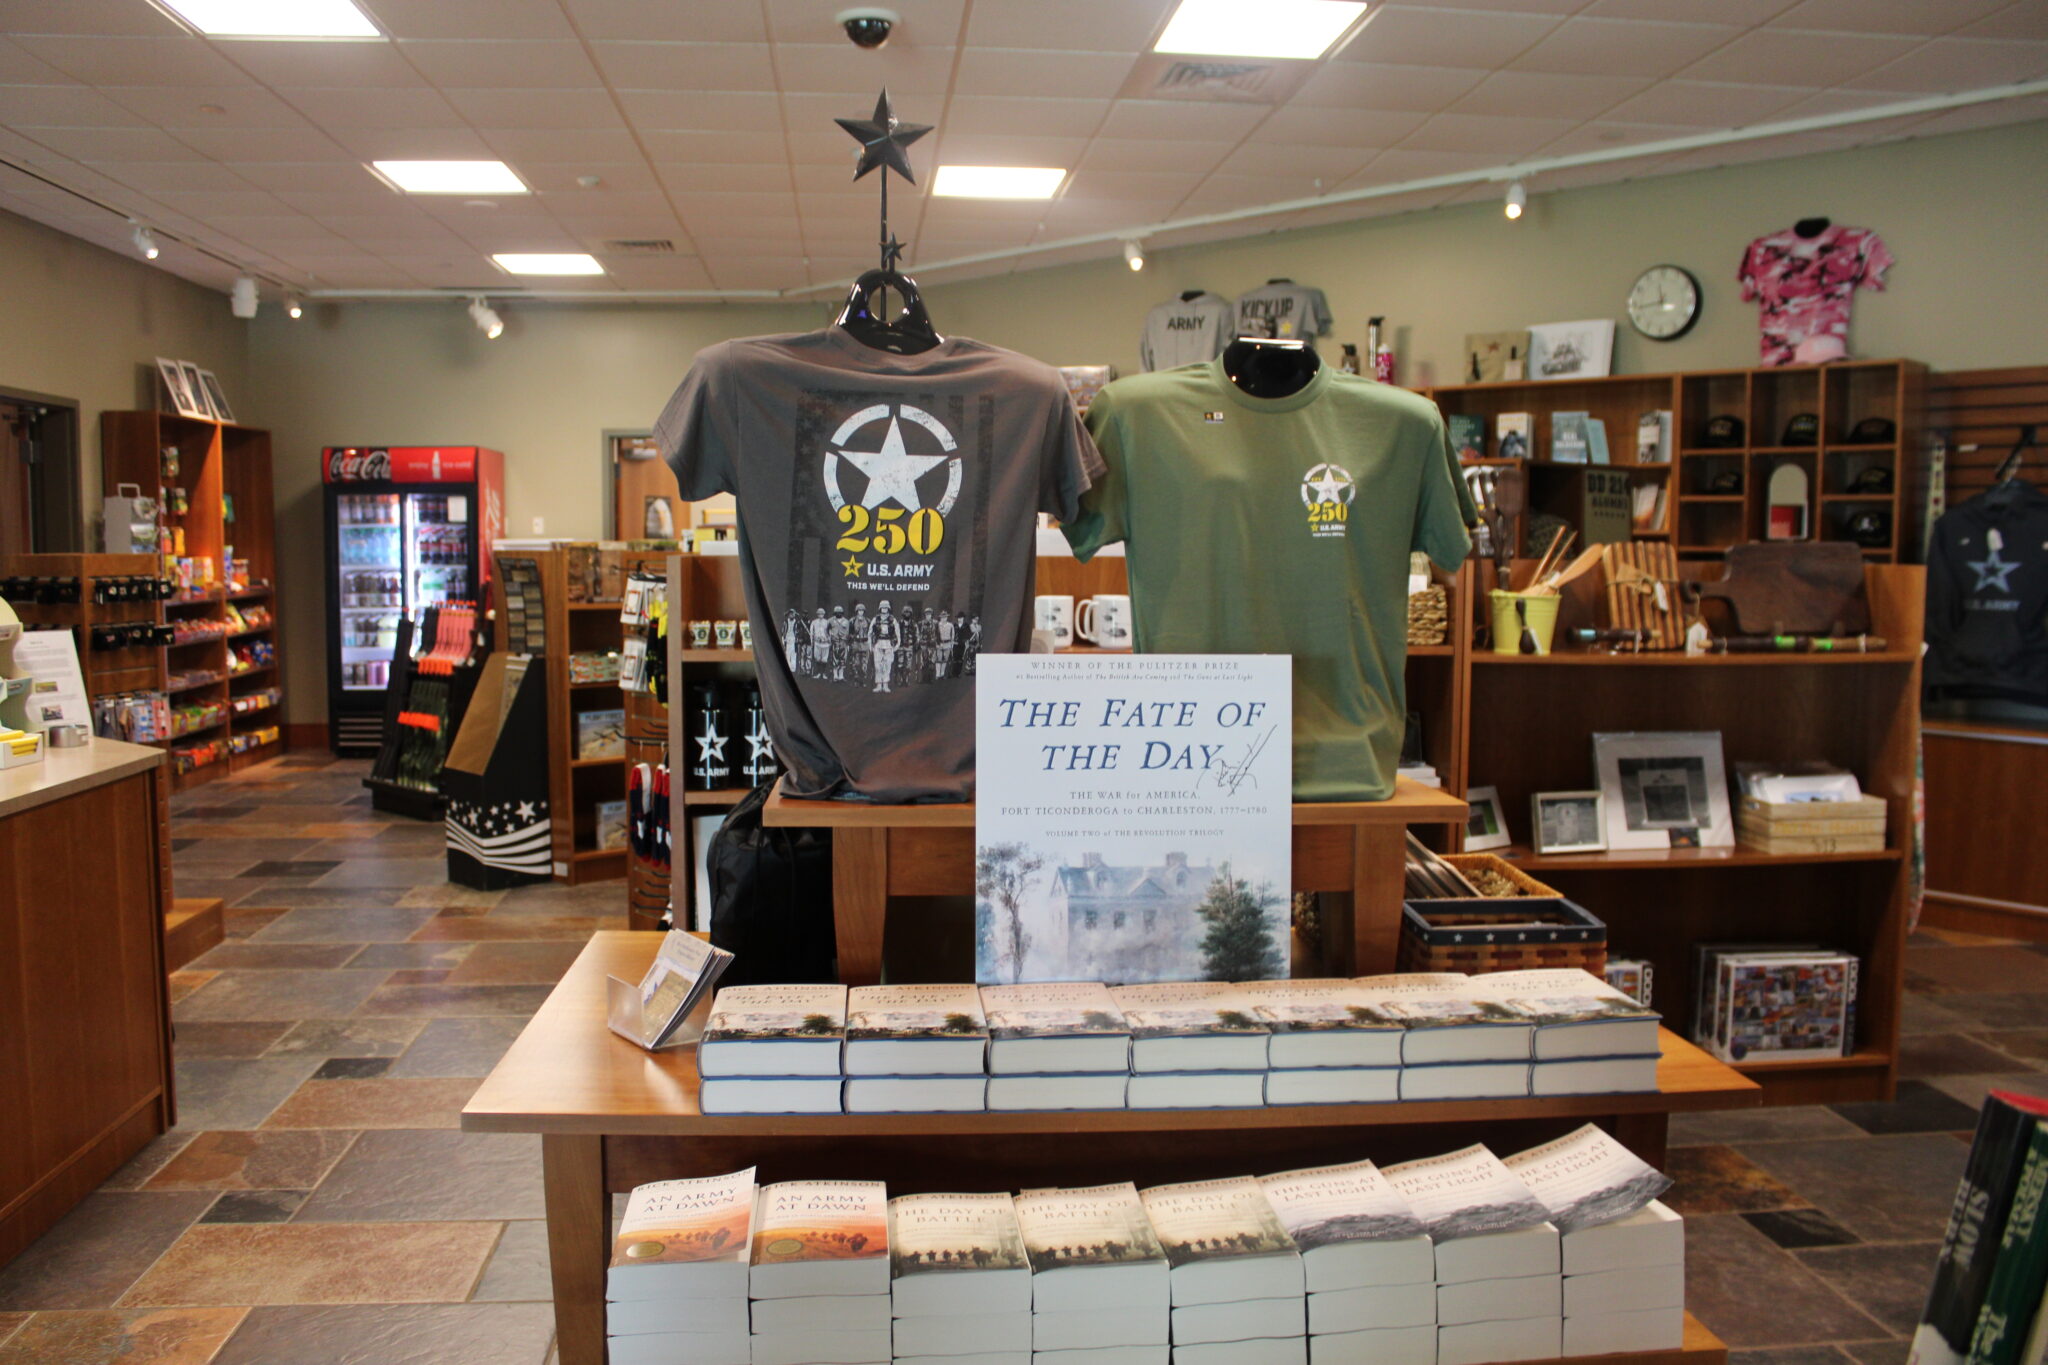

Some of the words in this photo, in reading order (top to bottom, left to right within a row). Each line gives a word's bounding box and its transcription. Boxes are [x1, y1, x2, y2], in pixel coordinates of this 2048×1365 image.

[1167, 316, 1206, 331] ARMY
[1307, 502, 1348, 522] 250
[836, 504, 945, 555] 250
[867, 564, 891, 577] U.S.
[894, 564, 934, 577] ARMY
[847, 581, 868, 590] THIS
[870, 582, 895, 591] WE'LL
[896, 583, 930, 591] DEFEND
[1031, 661, 1082, 670] WINNER
[1088, 661, 1102, 670] OF
[1109, 661, 1133, 670] THE
[1139, 661, 1198, 670] PULITZER
[1204, 661, 1239, 670] PRIZE
[1000, 698, 1081, 727] THE
[1099, 699, 1197, 727] FATE
[1216, 701, 1266, 727] OF
[1042, 745, 1121, 770] THE
[1140, 741, 1224, 770] DAY
[693, 767, 706, 776] U.S.
[708, 768, 730, 776] ARMY
[743, 766, 757, 775] U.S.
[758, 766, 778, 775] ARMY
[1071, 791, 1093, 799] THE
[1097, 791, 1122, 799] WAR
[1126, 791, 1141, 799] for
[1001, 807, 1030, 815] FORT
[1035, 807, 1119, 815] TICONDEROGA
[1123, 807, 1133, 815] to
[1137, 807, 1216, 816] CHARLESTON,
[1189, 829, 1225, 837] TRILOGY
[1531, 1127, 1593, 1157] ATKINSON
[1416, 1148, 1482, 1168] ATKINSON
[1545, 1150, 1588, 1170] GUNS
[1591, 1140, 1608, 1154] AT
[1262, 1173, 1291, 1184] RICK
[1300, 1163, 1369, 1176] ATKINSON
[1391, 1174, 1423, 1190] THE
[1428, 1166, 1471, 1181] GUNS
[1472, 1160, 1493, 1173] AT
[1524, 1171, 1560, 1187] LAST
[1565, 1151, 1610, 1174] LIGHT
[638, 1182, 669, 1192] RICK
[677, 1170, 751, 1186] ATKINSON
[765, 1182, 798, 1191] RICK
[1178, 1178, 1249, 1189] ATKINSON
[1273, 1185, 1304, 1196] THE
[1310, 1179, 1355, 1190] GUNS
[1359, 1176, 1376, 1184] AT
[1405, 1182, 1441, 1195] LAST
[1448, 1171, 1494, 1187] LIGHT
[646, 1195, 672, 1204] AN
[682, 1187, 737, 1201] ARMY
[1055, 1184, 1127, 1195] ATKINSON
[1285, 1188, 1321, 1201] LAST
[1328, 1185, 1376, 1196] LIGHT
[644, 1204, 668, 1213] AT
[676, 1196, 735, 1210] DAWN
[1065, 1202, 1098, 1210] DAY
[1191, 1194, 1223, 1203] DAY
[807, 1203, 866, 1211] DAWN
[1045, 1210, 1112, 1219] BATTLE
[1172, 1202, 1240, 1213] BATTLE
